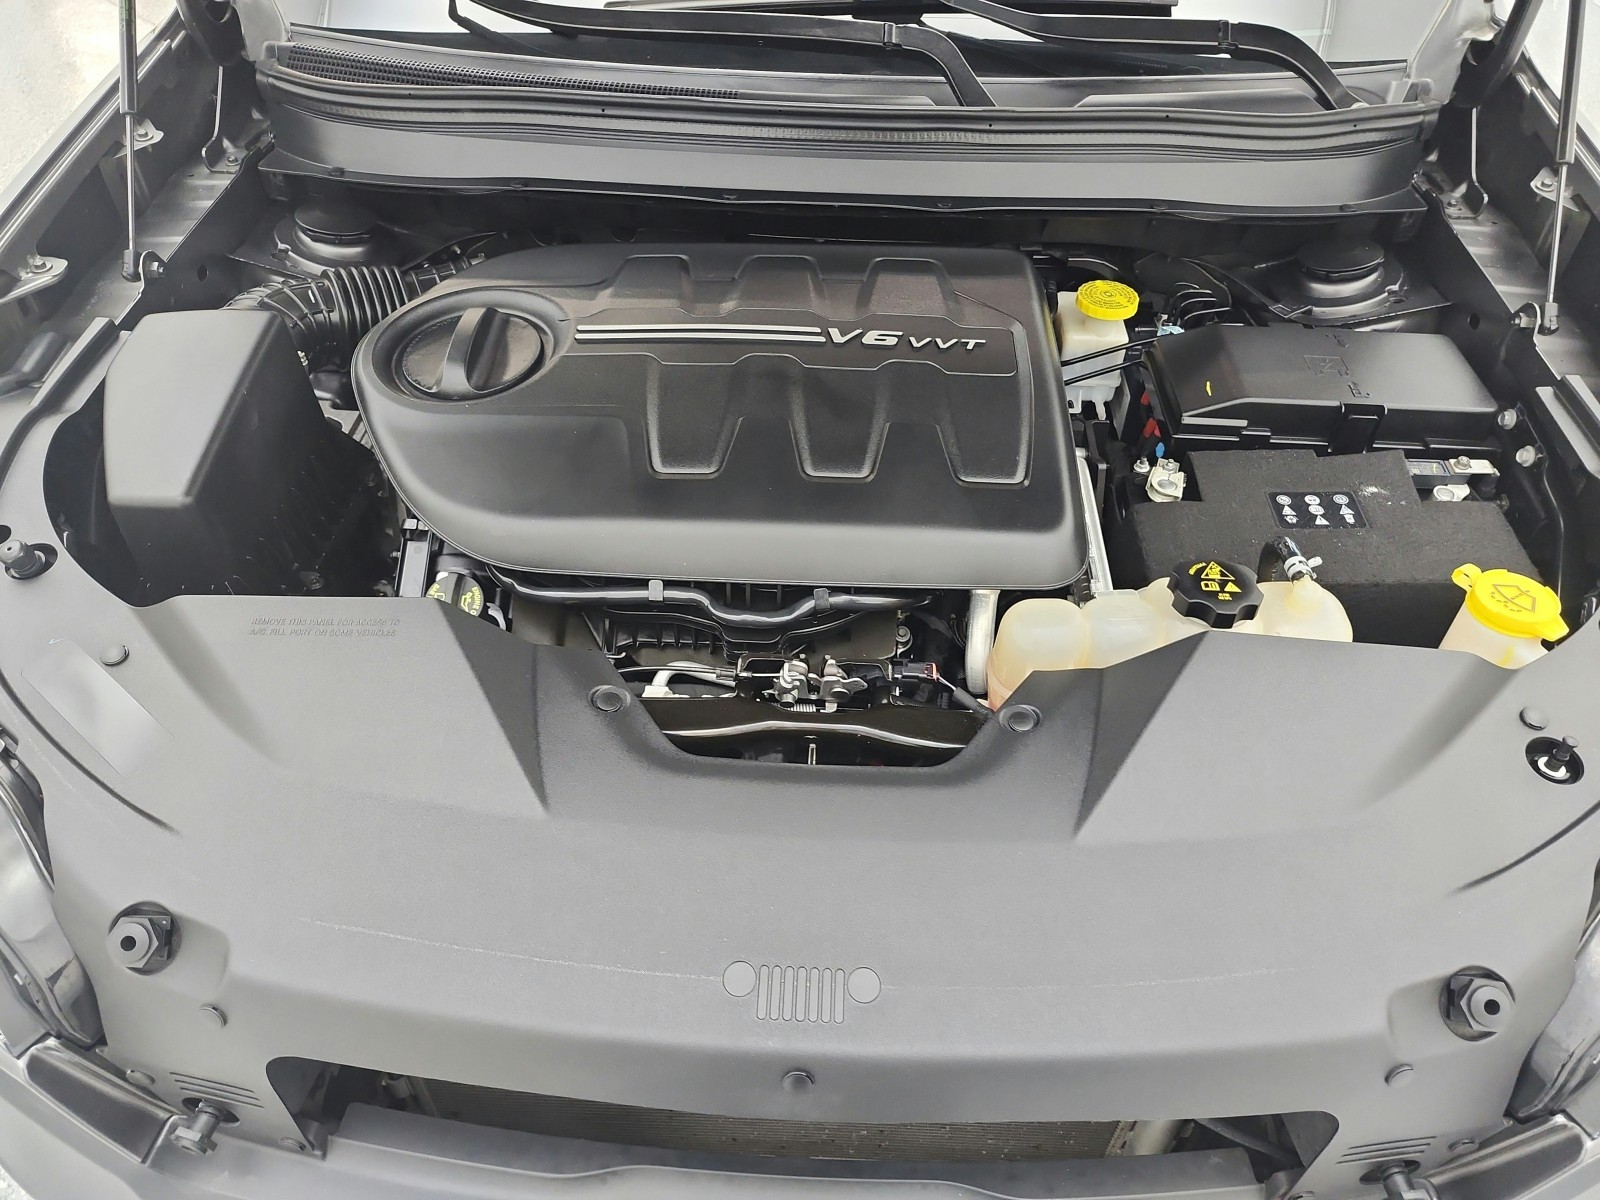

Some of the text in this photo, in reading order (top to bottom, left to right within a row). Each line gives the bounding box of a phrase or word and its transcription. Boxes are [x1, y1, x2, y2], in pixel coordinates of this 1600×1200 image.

[827, 327, 987, 350] V6 VVT
[471, 586, 481, 610] ENGINE
[251, 617, 287, 625] REMOVE
[288, 618, 307, 626] THIS
[308, 618, 335, 626] PANEL
[355, 619, 387, 627] ACCESS
[390, 618, 401, 626] TO
[249, 627, 397, 637] A/C FILL PORT ON SOME VEHICLES
